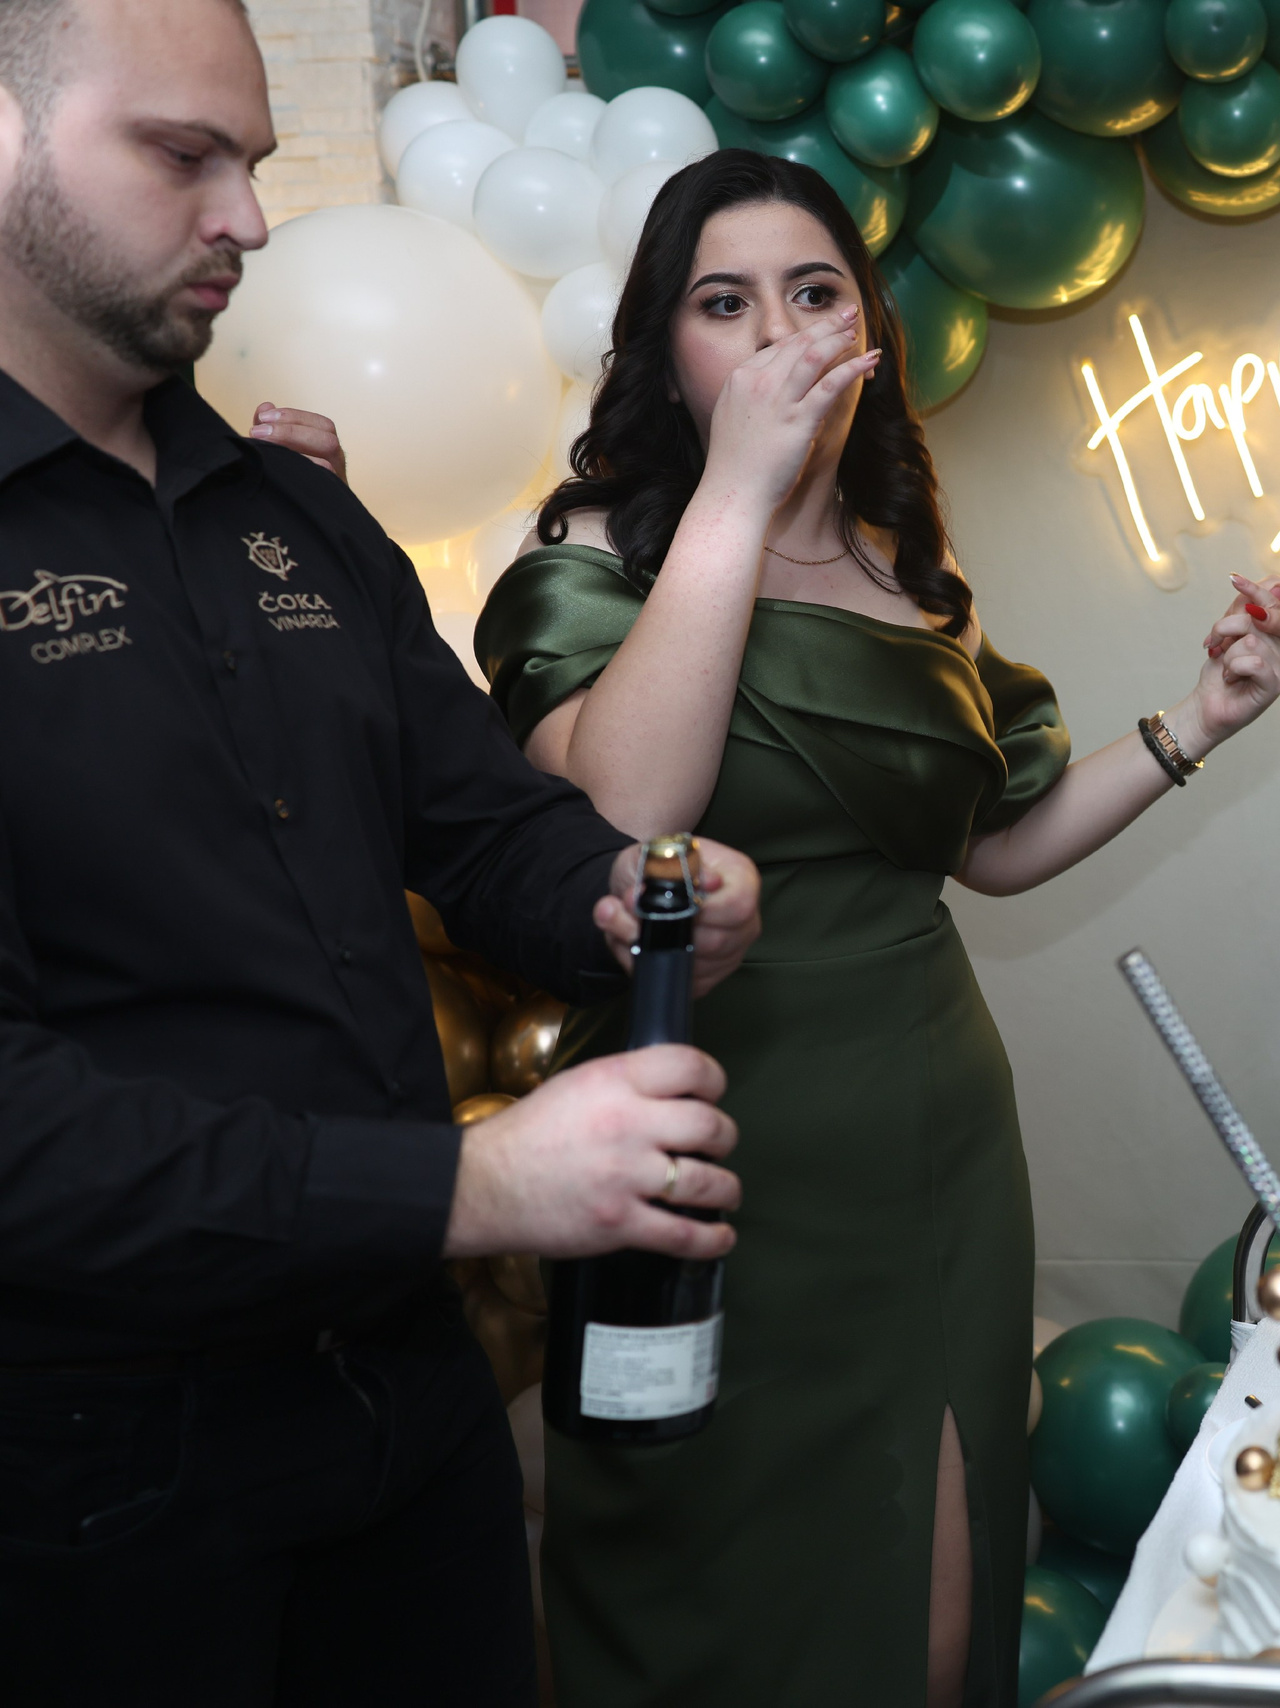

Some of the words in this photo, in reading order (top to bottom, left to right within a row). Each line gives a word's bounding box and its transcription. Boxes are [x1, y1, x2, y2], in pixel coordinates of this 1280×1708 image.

[0, 577, 126, 631] Delfin
[258, 591, 332, 613] ČOKA
[267, 613, 341, 632] VINARIJA
[30, 626, 133, 664] COMPLEX
